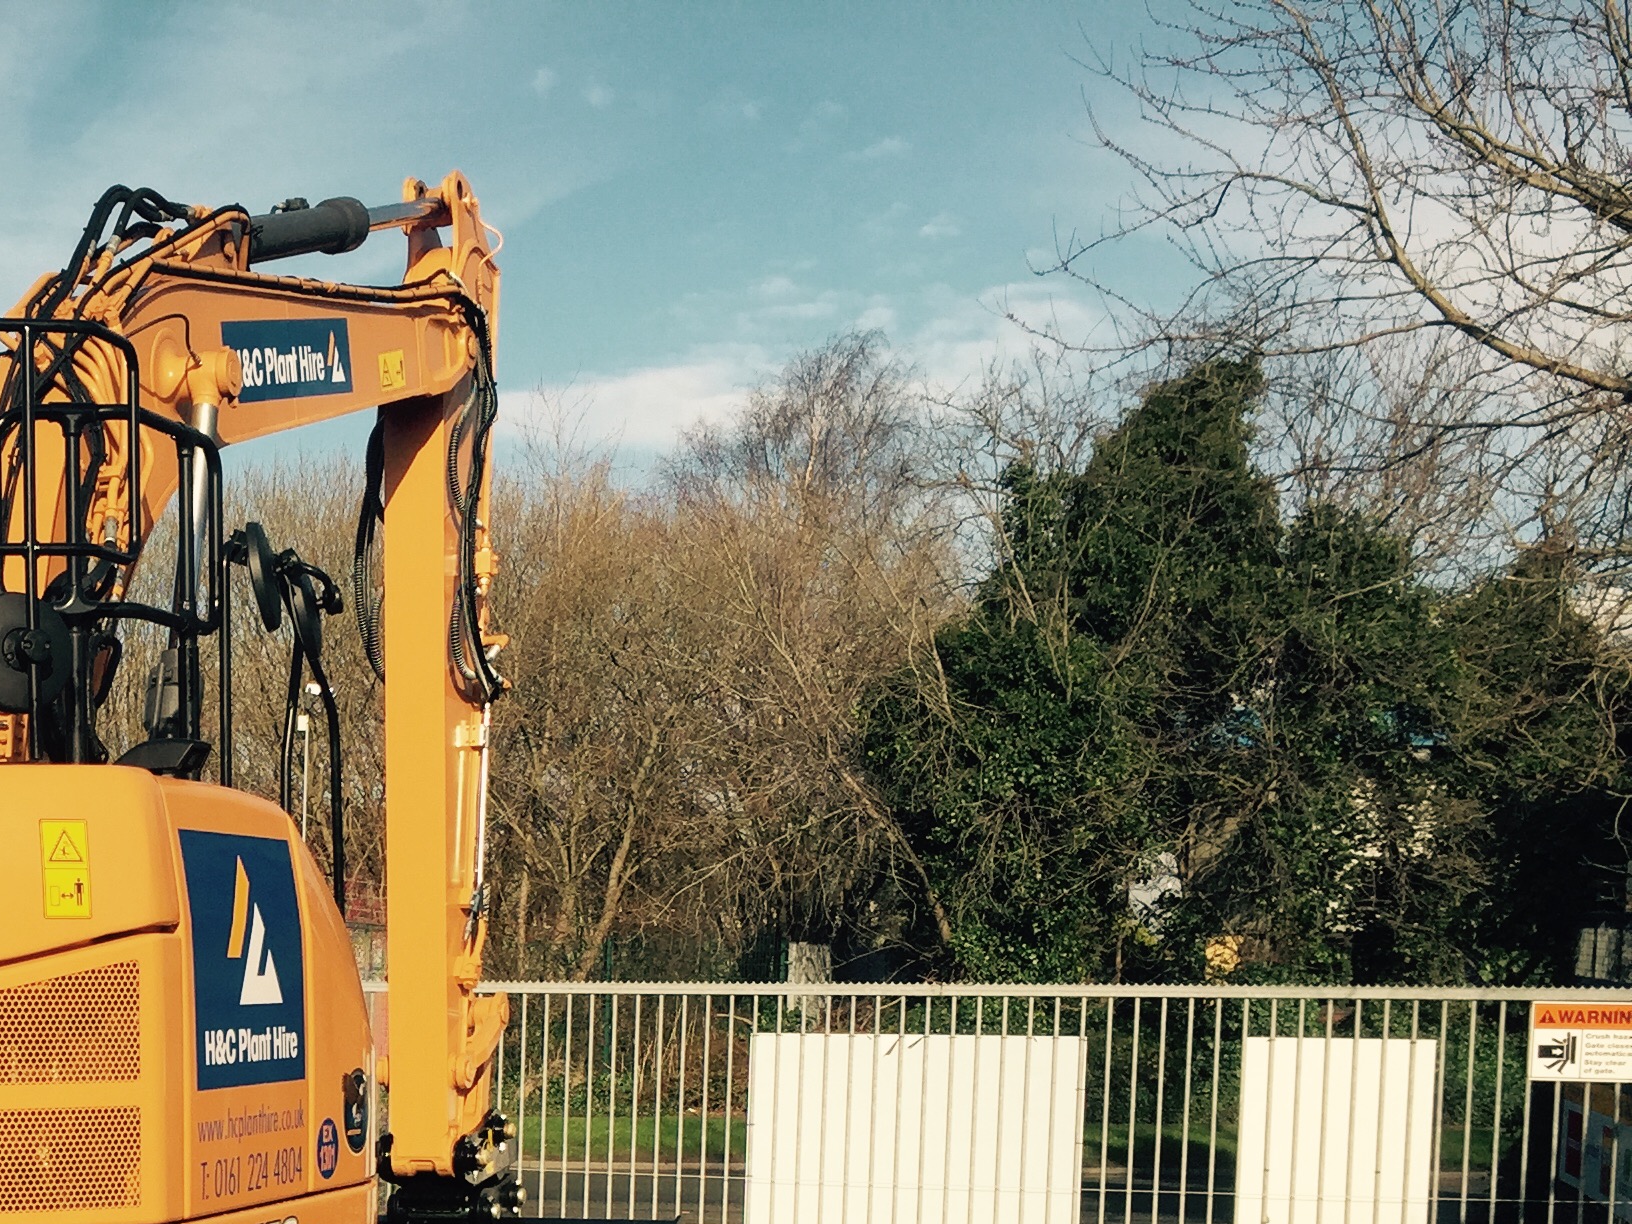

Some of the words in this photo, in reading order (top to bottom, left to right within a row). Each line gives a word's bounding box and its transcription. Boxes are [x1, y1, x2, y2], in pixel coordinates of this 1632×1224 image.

[264, 346, 298, 385] Plant
[298, 345, 326, 383] Hire
[204, 1028, 236, 1066] H&C
[238, 1026, 272, 1063] Plant
[273, 1025, 298, 1060] Hire
[1584, 1059, 1602, 1067] Stay
[197, 1099, 305, 1144] www.hcplanthire.co.uk
[201, 1161, 210, 1200] T:
[214, 1156, 241, 1198] 0161
[247, 1152, 268, 1192] 224
[273, 1145, 303, 1187] 4804
